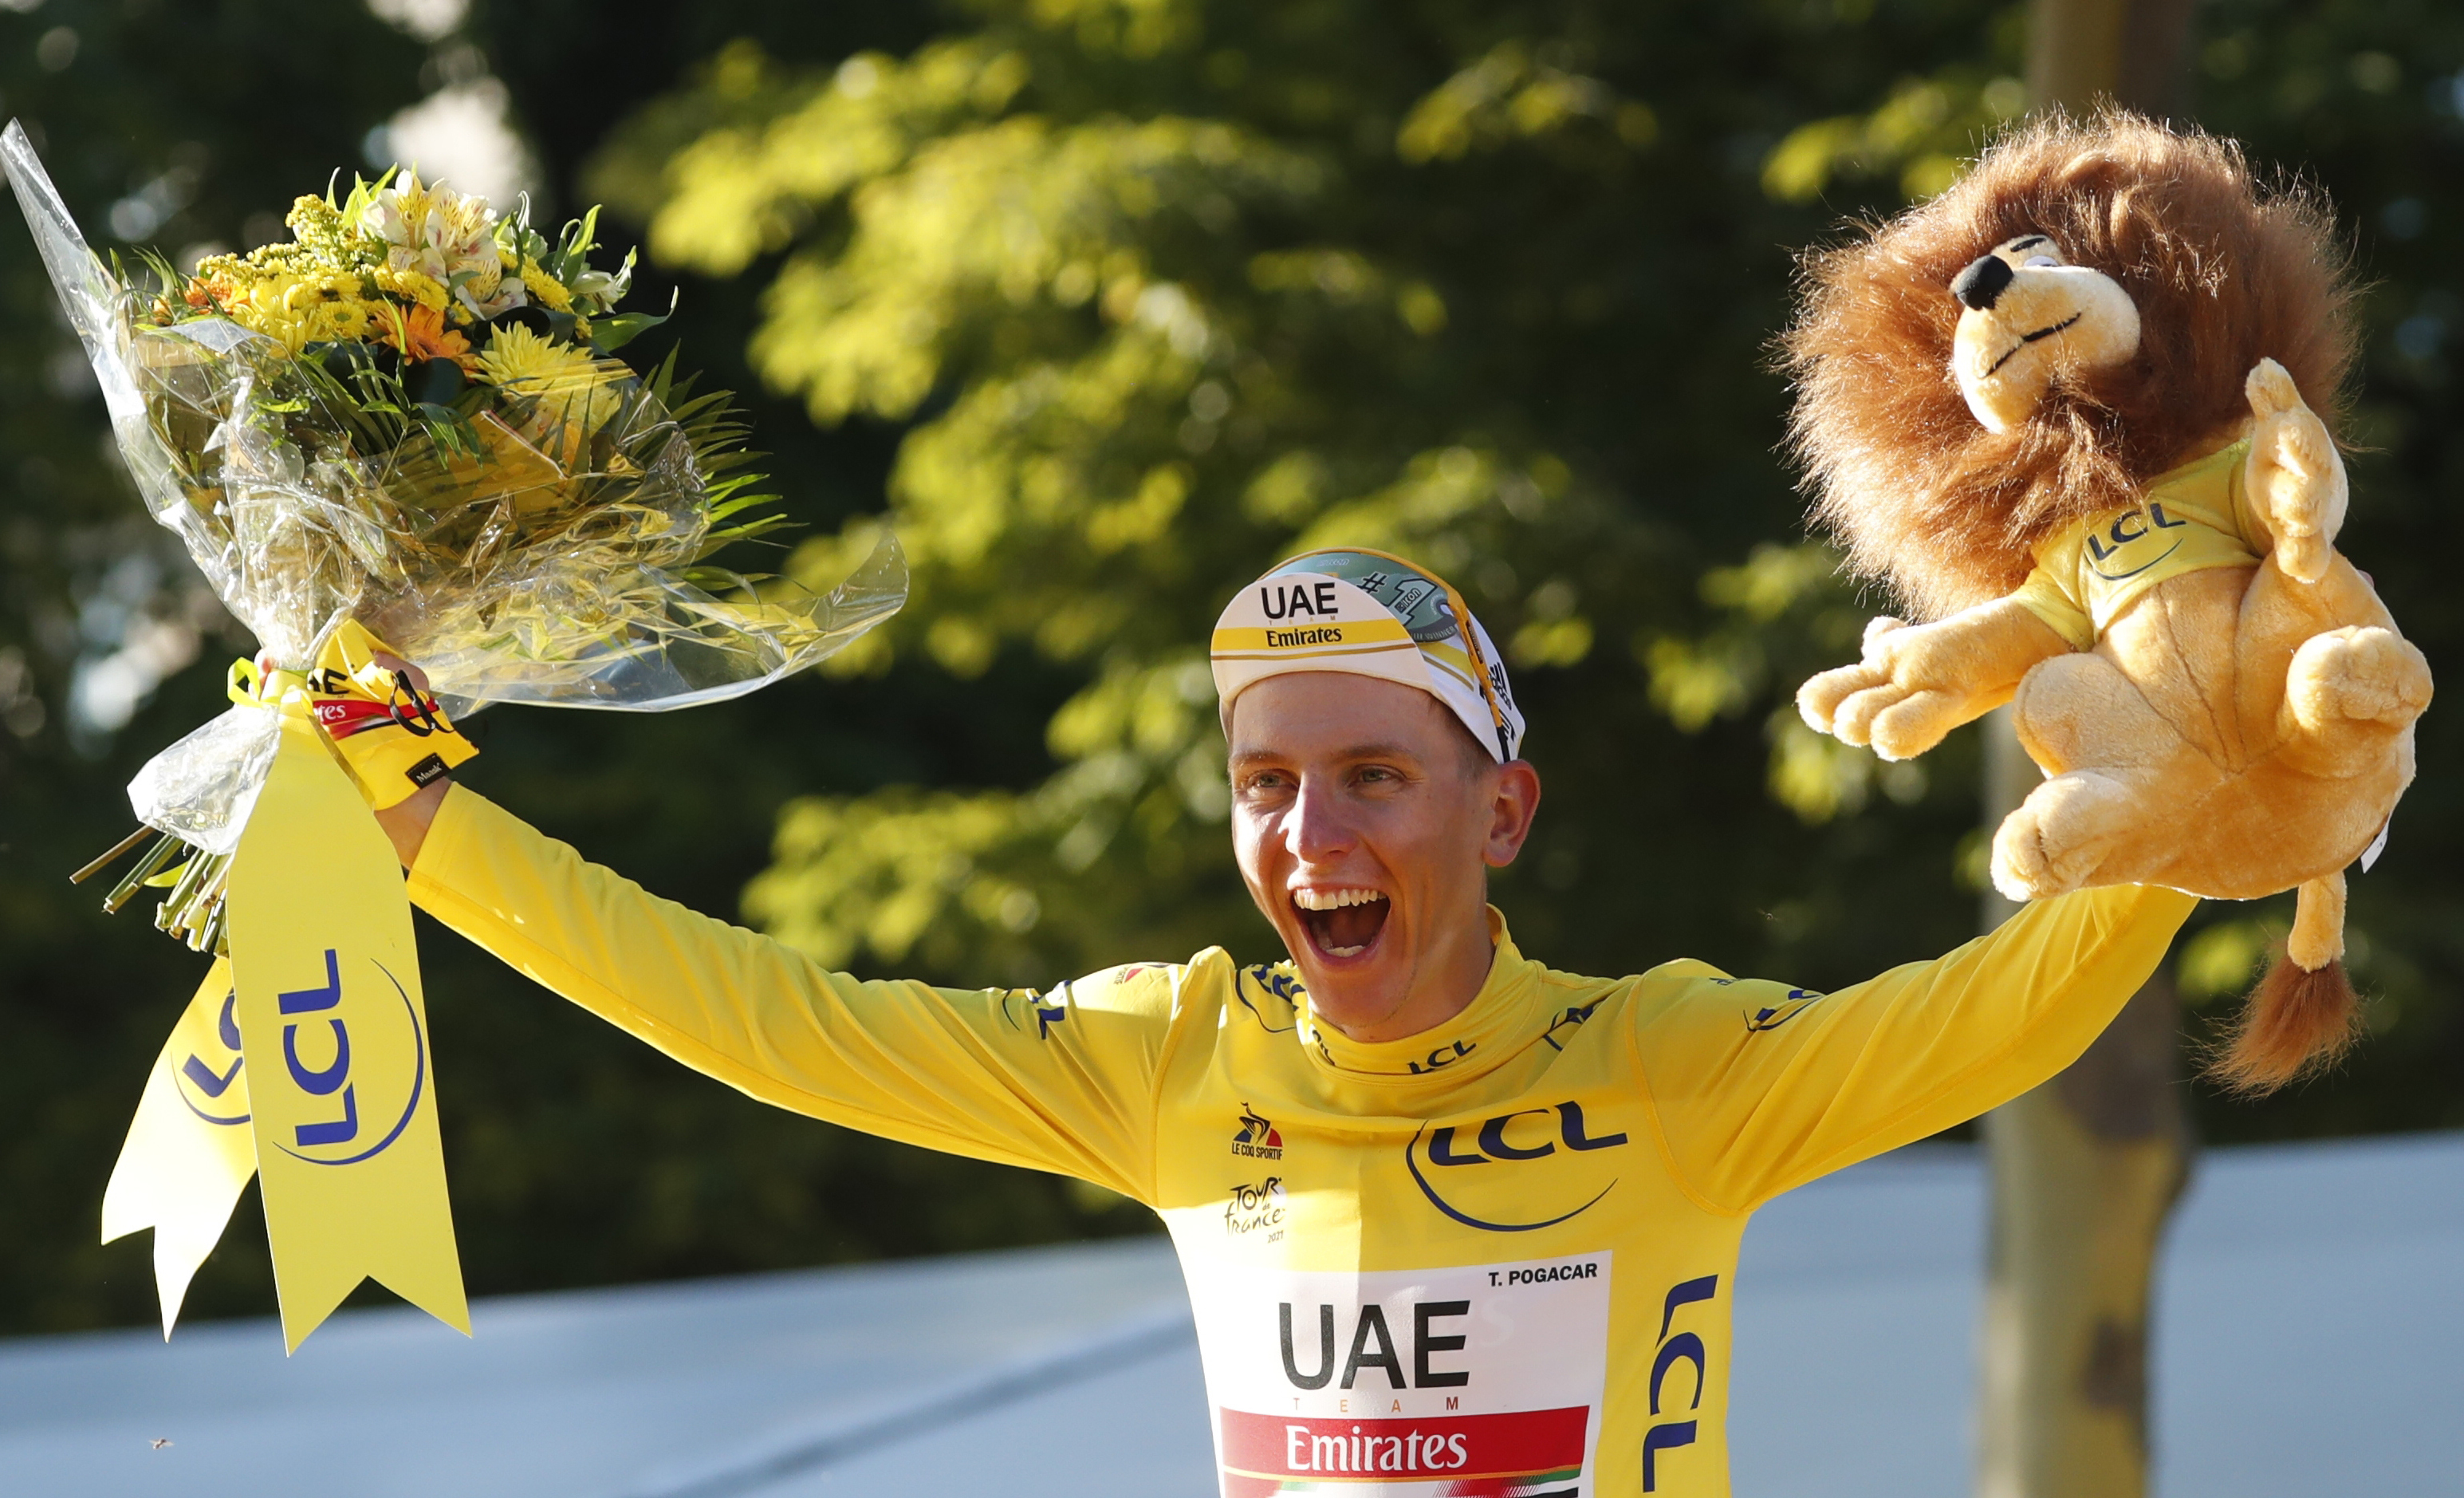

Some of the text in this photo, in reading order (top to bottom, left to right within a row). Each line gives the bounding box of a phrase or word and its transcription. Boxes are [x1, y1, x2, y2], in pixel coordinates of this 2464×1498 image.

[2087, 502, 2187, 561] LCL
[1261, 582, 1339, 620] UAE
[1265, 627, 1343, 648] Emirates
[182, 985, 244, 1098] LC
[277, 948, 359, 1147] LCL
[1407, 1039, 1477, 1074] LCL
[1232, 1141, 1283, 1161] LE COQ SPORTIF
[1428, 1100, 1628, 1166] LCL
[1229, 1177, 1282, 1212] TOUR
[1267, 1229, 1285, 1244] 2021
[1488, 1263, 1598, 1287] T. POGACAR
[1278, 1299, 1470, 1391] UAE
[1643, 1274, 1718, 1494] LCL
[1293, 1396, 1459, 1413] TEAM
[1285, 1425, 1468, 1472] Emirates
